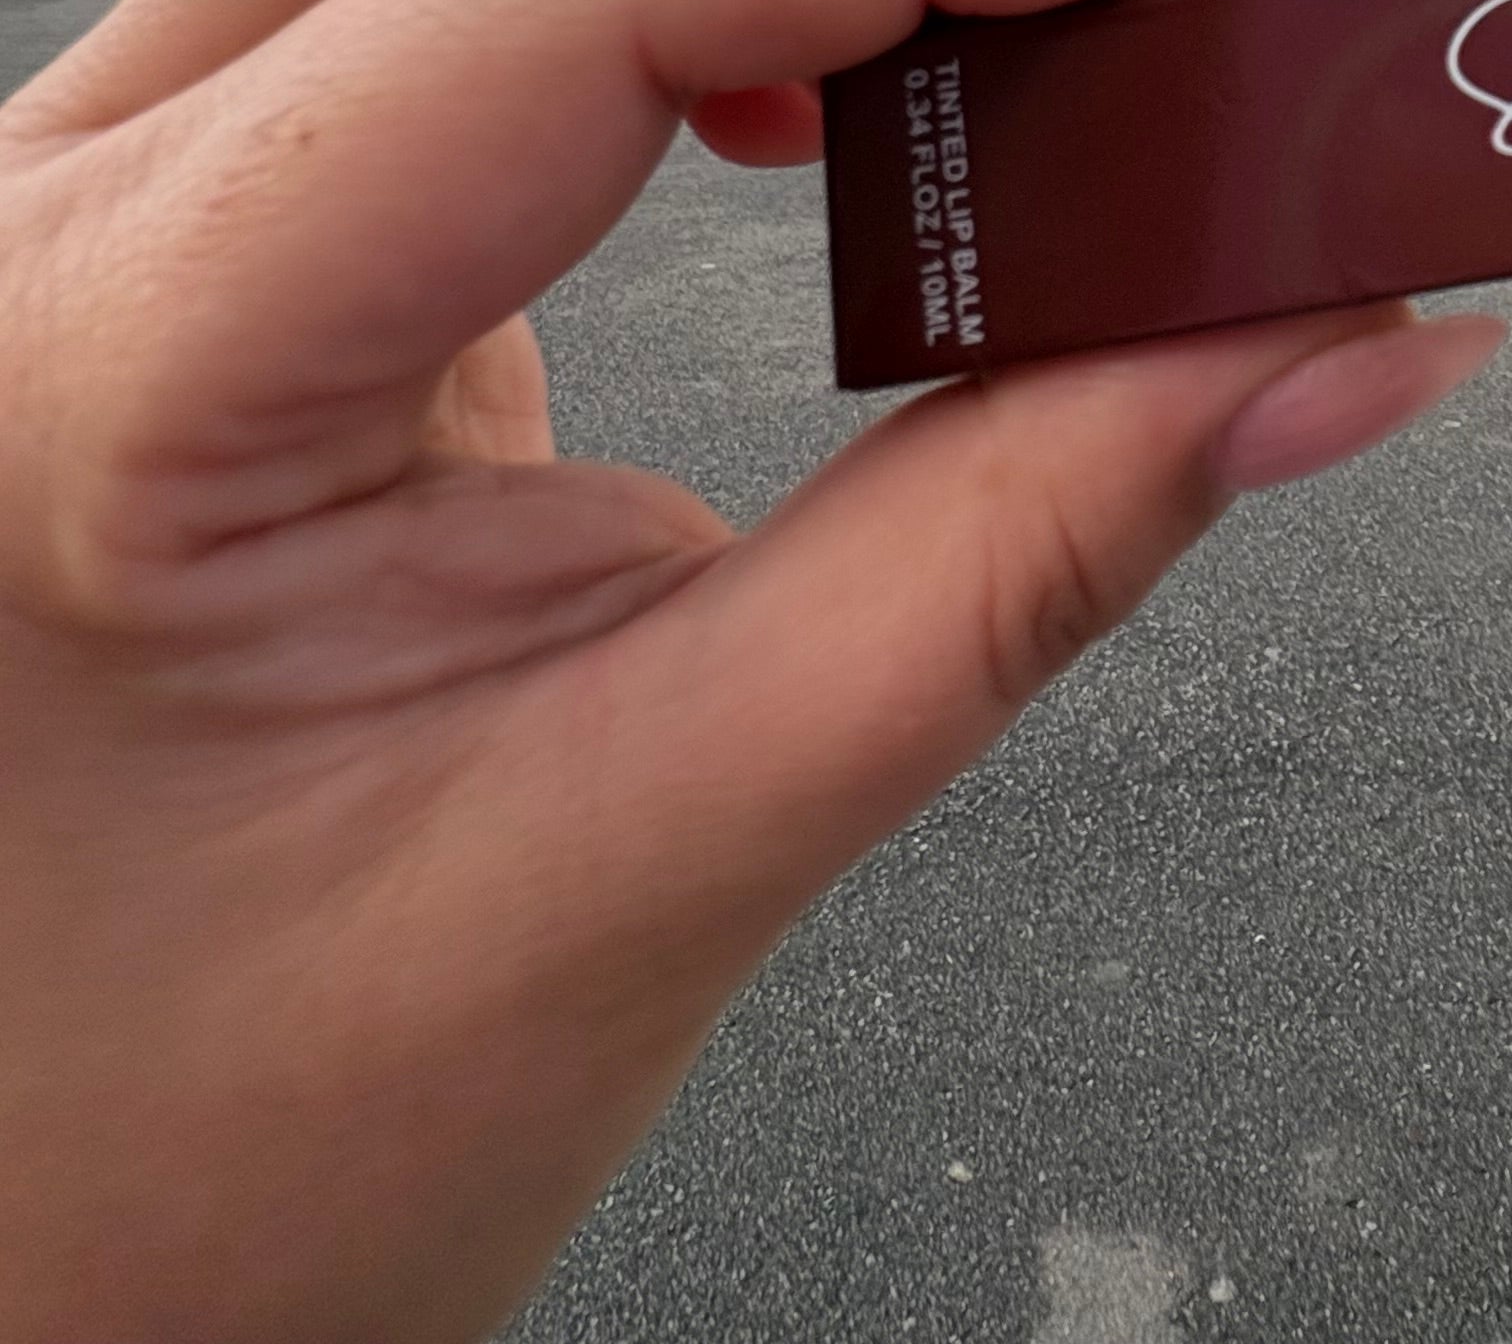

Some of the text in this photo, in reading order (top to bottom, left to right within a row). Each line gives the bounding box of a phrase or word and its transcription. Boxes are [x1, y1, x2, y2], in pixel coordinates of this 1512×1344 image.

[903, 68, 934, 137] 0.34
[921, 257, 952, 347] 10ML
[935, 57, 985, 346] TINTED LIP BALM
